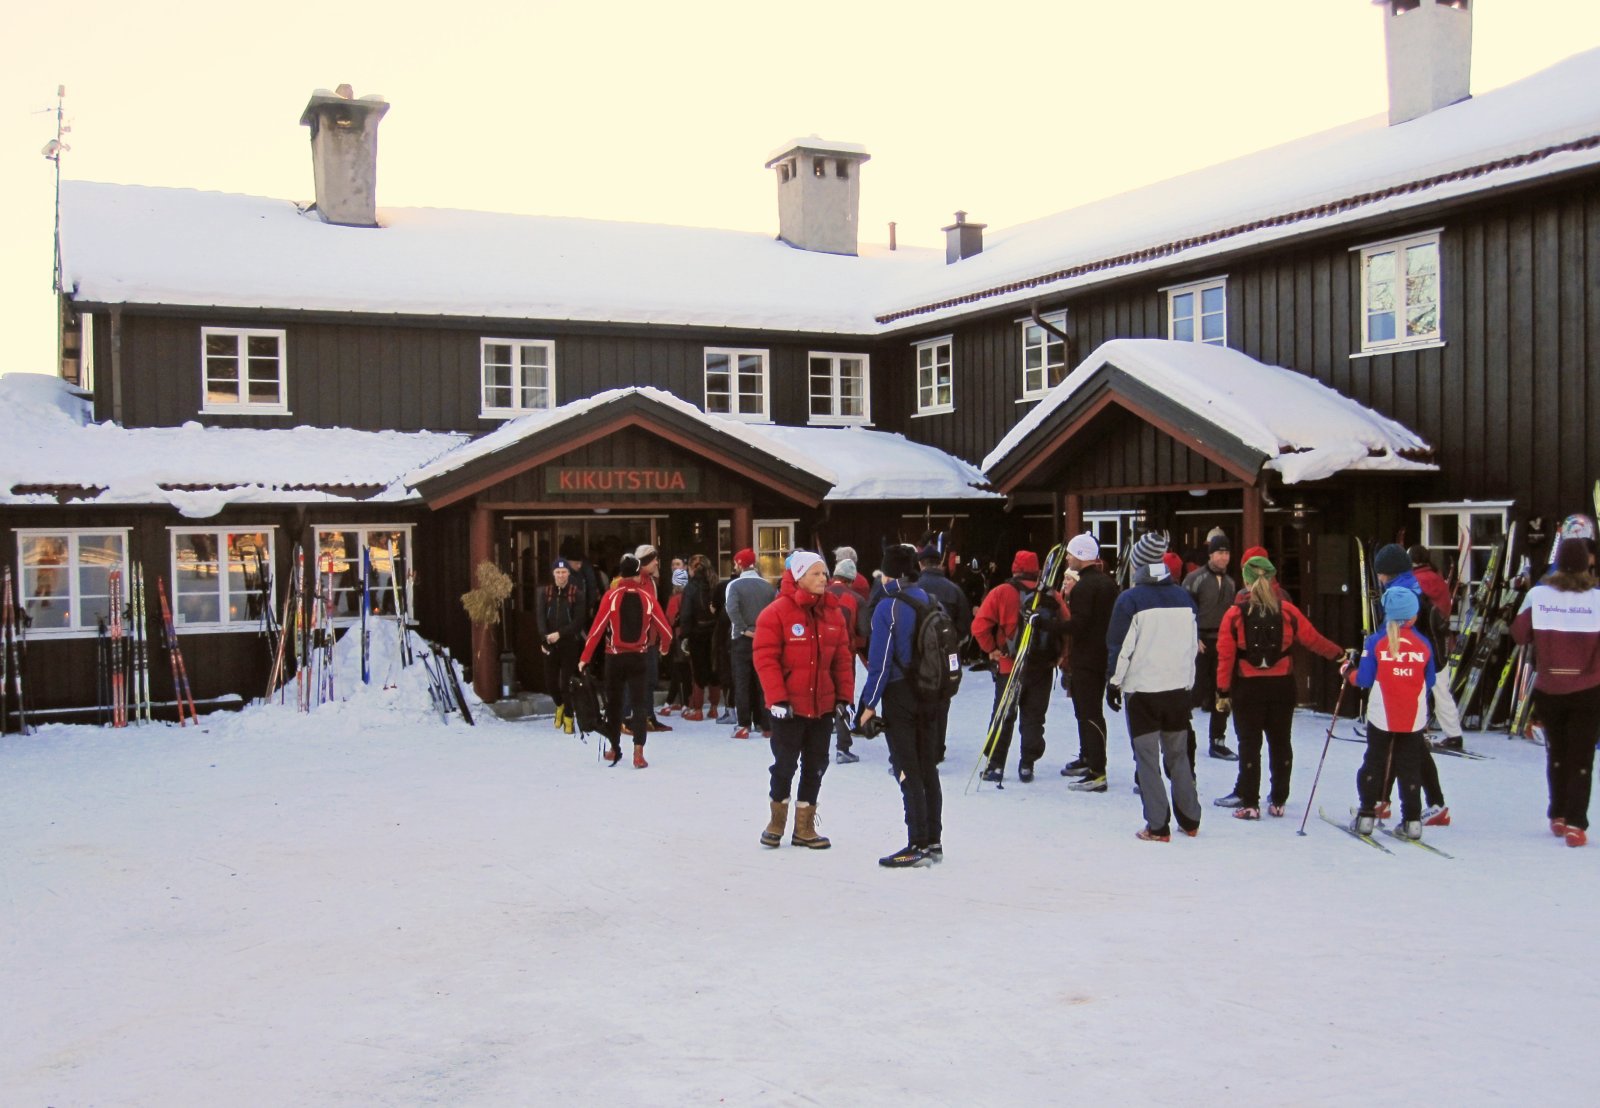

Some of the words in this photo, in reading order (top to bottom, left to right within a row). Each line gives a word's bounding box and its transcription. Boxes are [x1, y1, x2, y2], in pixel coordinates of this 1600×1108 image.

[560, 470, 685, 490] KIKUTSTUA
[1380, 650, 1425, 663] LYN
[1392, 667, 1413, 677] SKI
